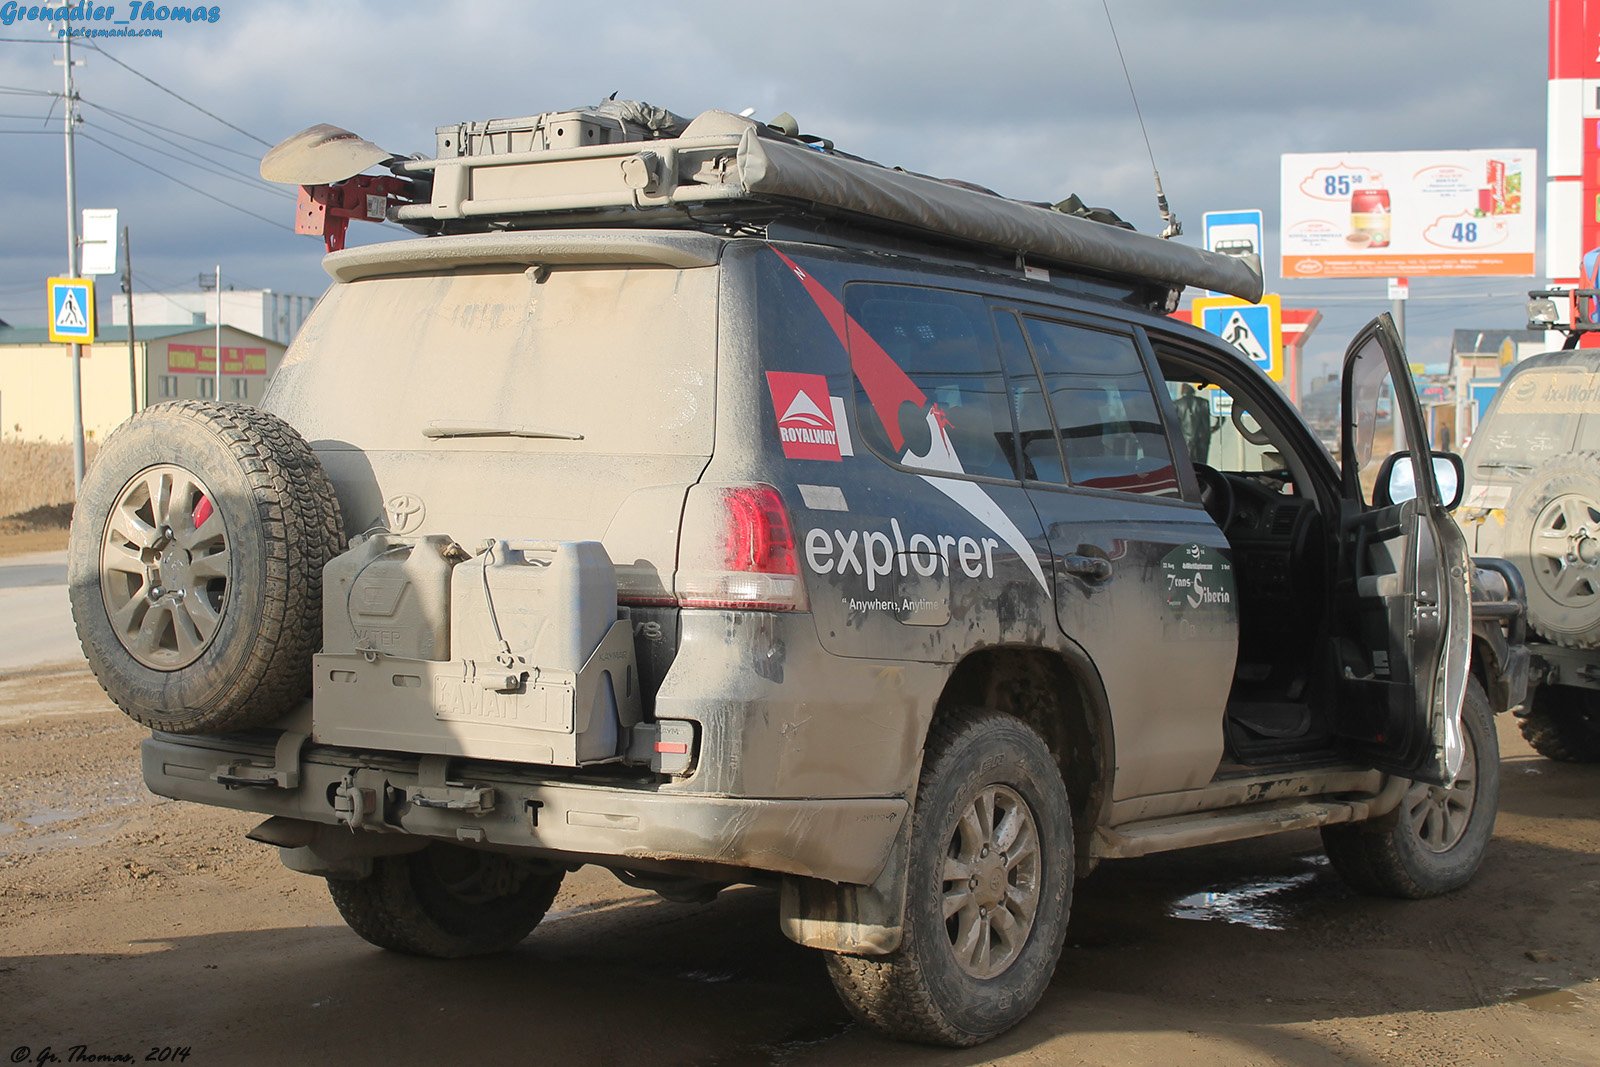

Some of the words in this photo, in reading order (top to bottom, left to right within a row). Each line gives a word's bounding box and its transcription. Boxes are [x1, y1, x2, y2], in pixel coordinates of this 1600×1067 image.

[1325, 175, 1350, 196] 85
[1352, 175, 1363, 183] 50
[1452, 222, 1478, 243] 48
[780, 427, 836, 445] ROYALWAY
[805, 517, 999, 592] explorer
[1187, 572, 1230, 609] Siberia
[849, 598, 900, 613] Anywhere,
[902, 598, 939, 613] Anytime
